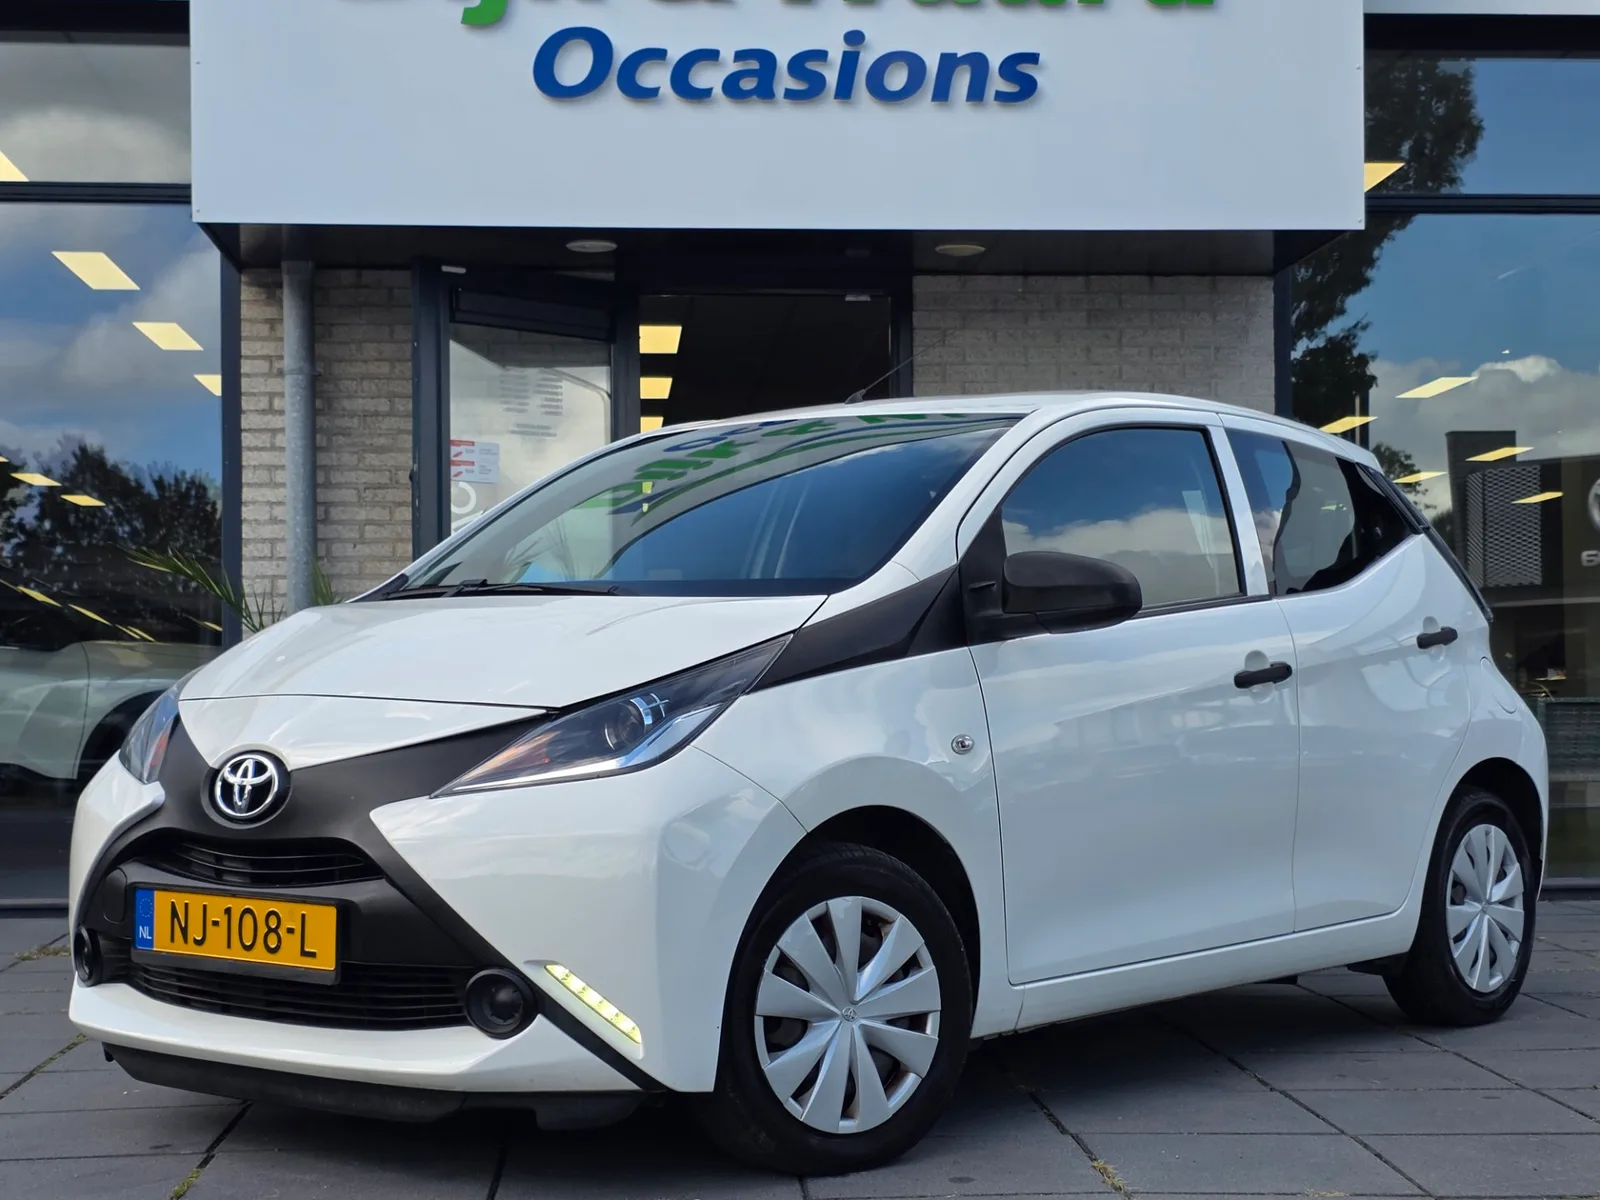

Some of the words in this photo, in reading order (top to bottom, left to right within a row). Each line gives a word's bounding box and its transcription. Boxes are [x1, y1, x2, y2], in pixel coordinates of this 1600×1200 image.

[532, 26, 1041, 104] Occasions
[138, 925, 152, 940] NL
[169, 899, 317, 959] NJ-108-L
